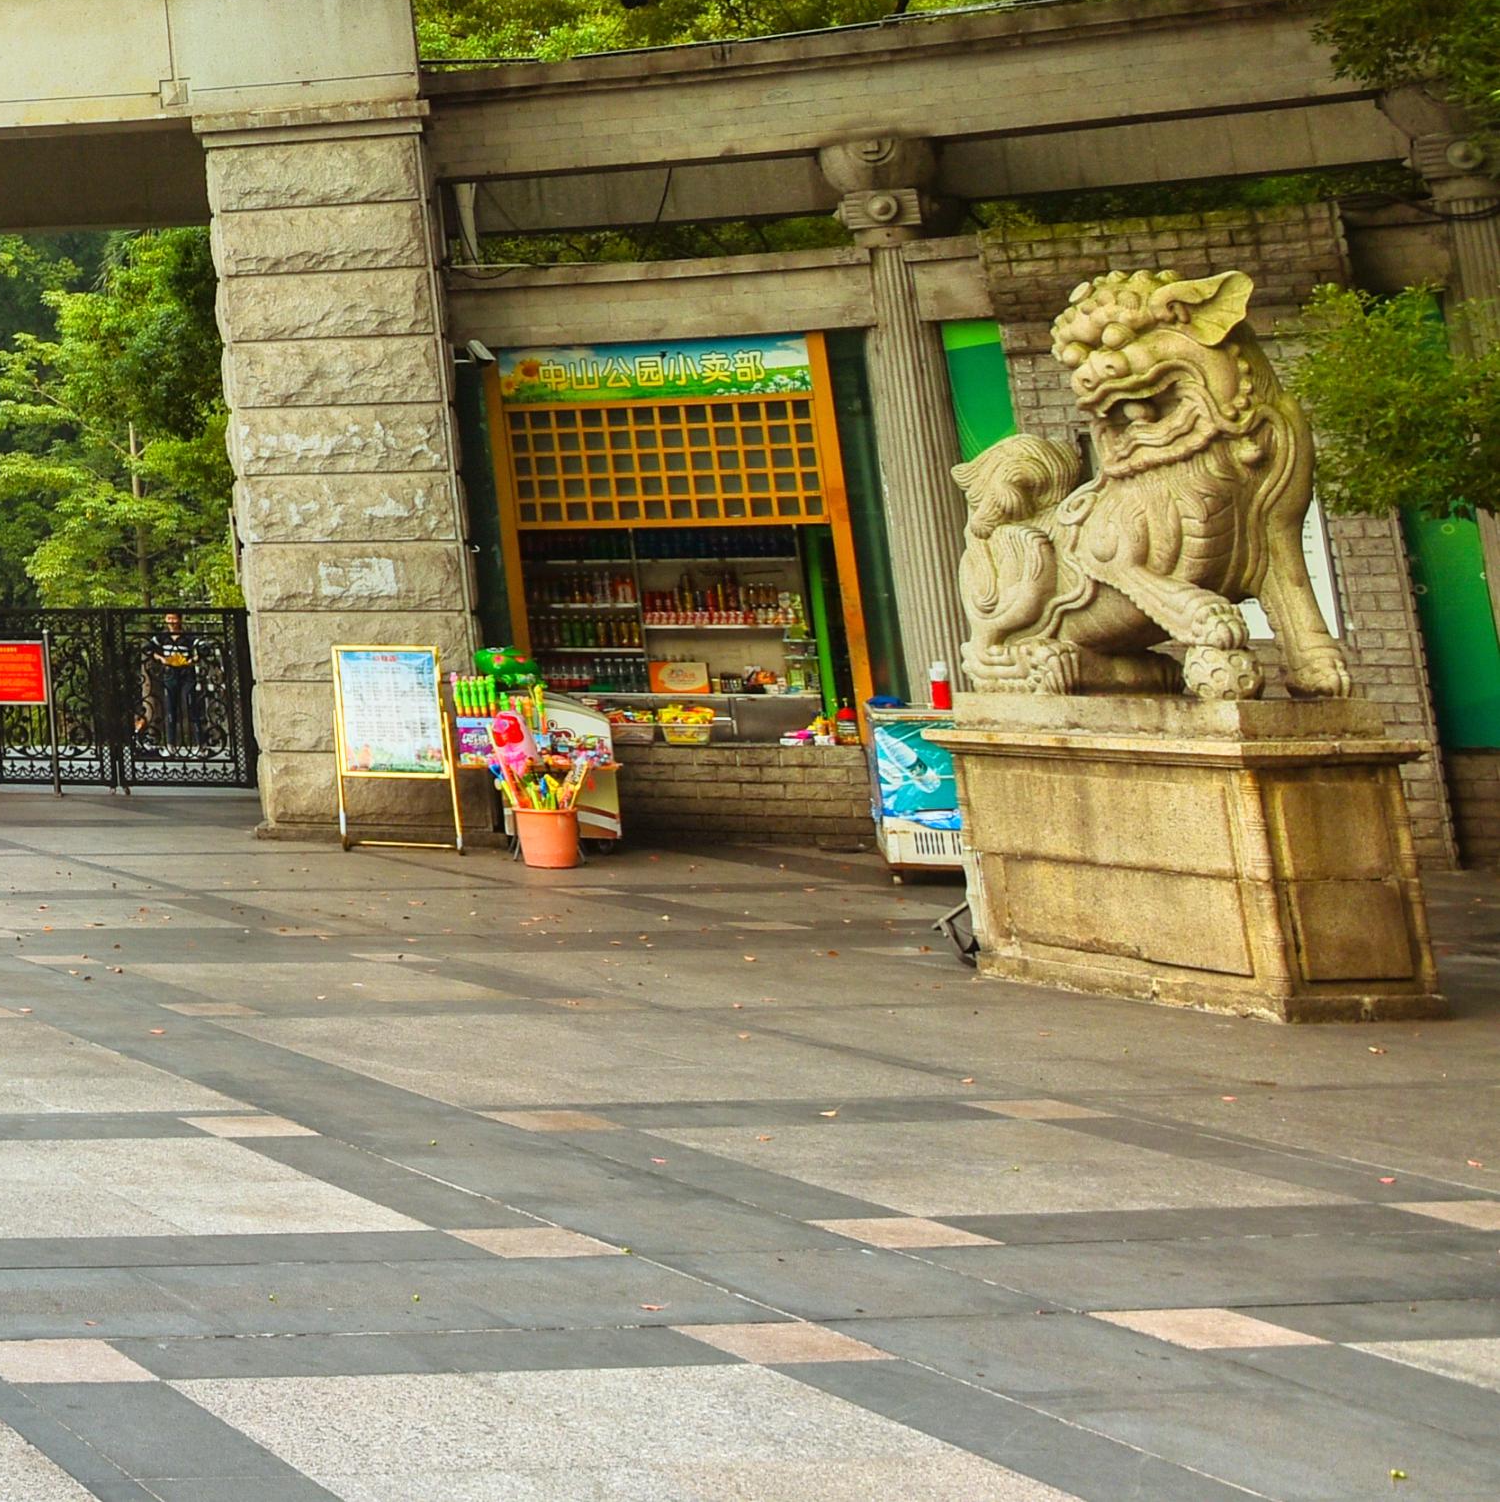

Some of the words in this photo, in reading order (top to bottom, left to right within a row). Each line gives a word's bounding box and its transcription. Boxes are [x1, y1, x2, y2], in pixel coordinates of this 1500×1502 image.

[538, 350, 766, 391] 中山公园小卖部
